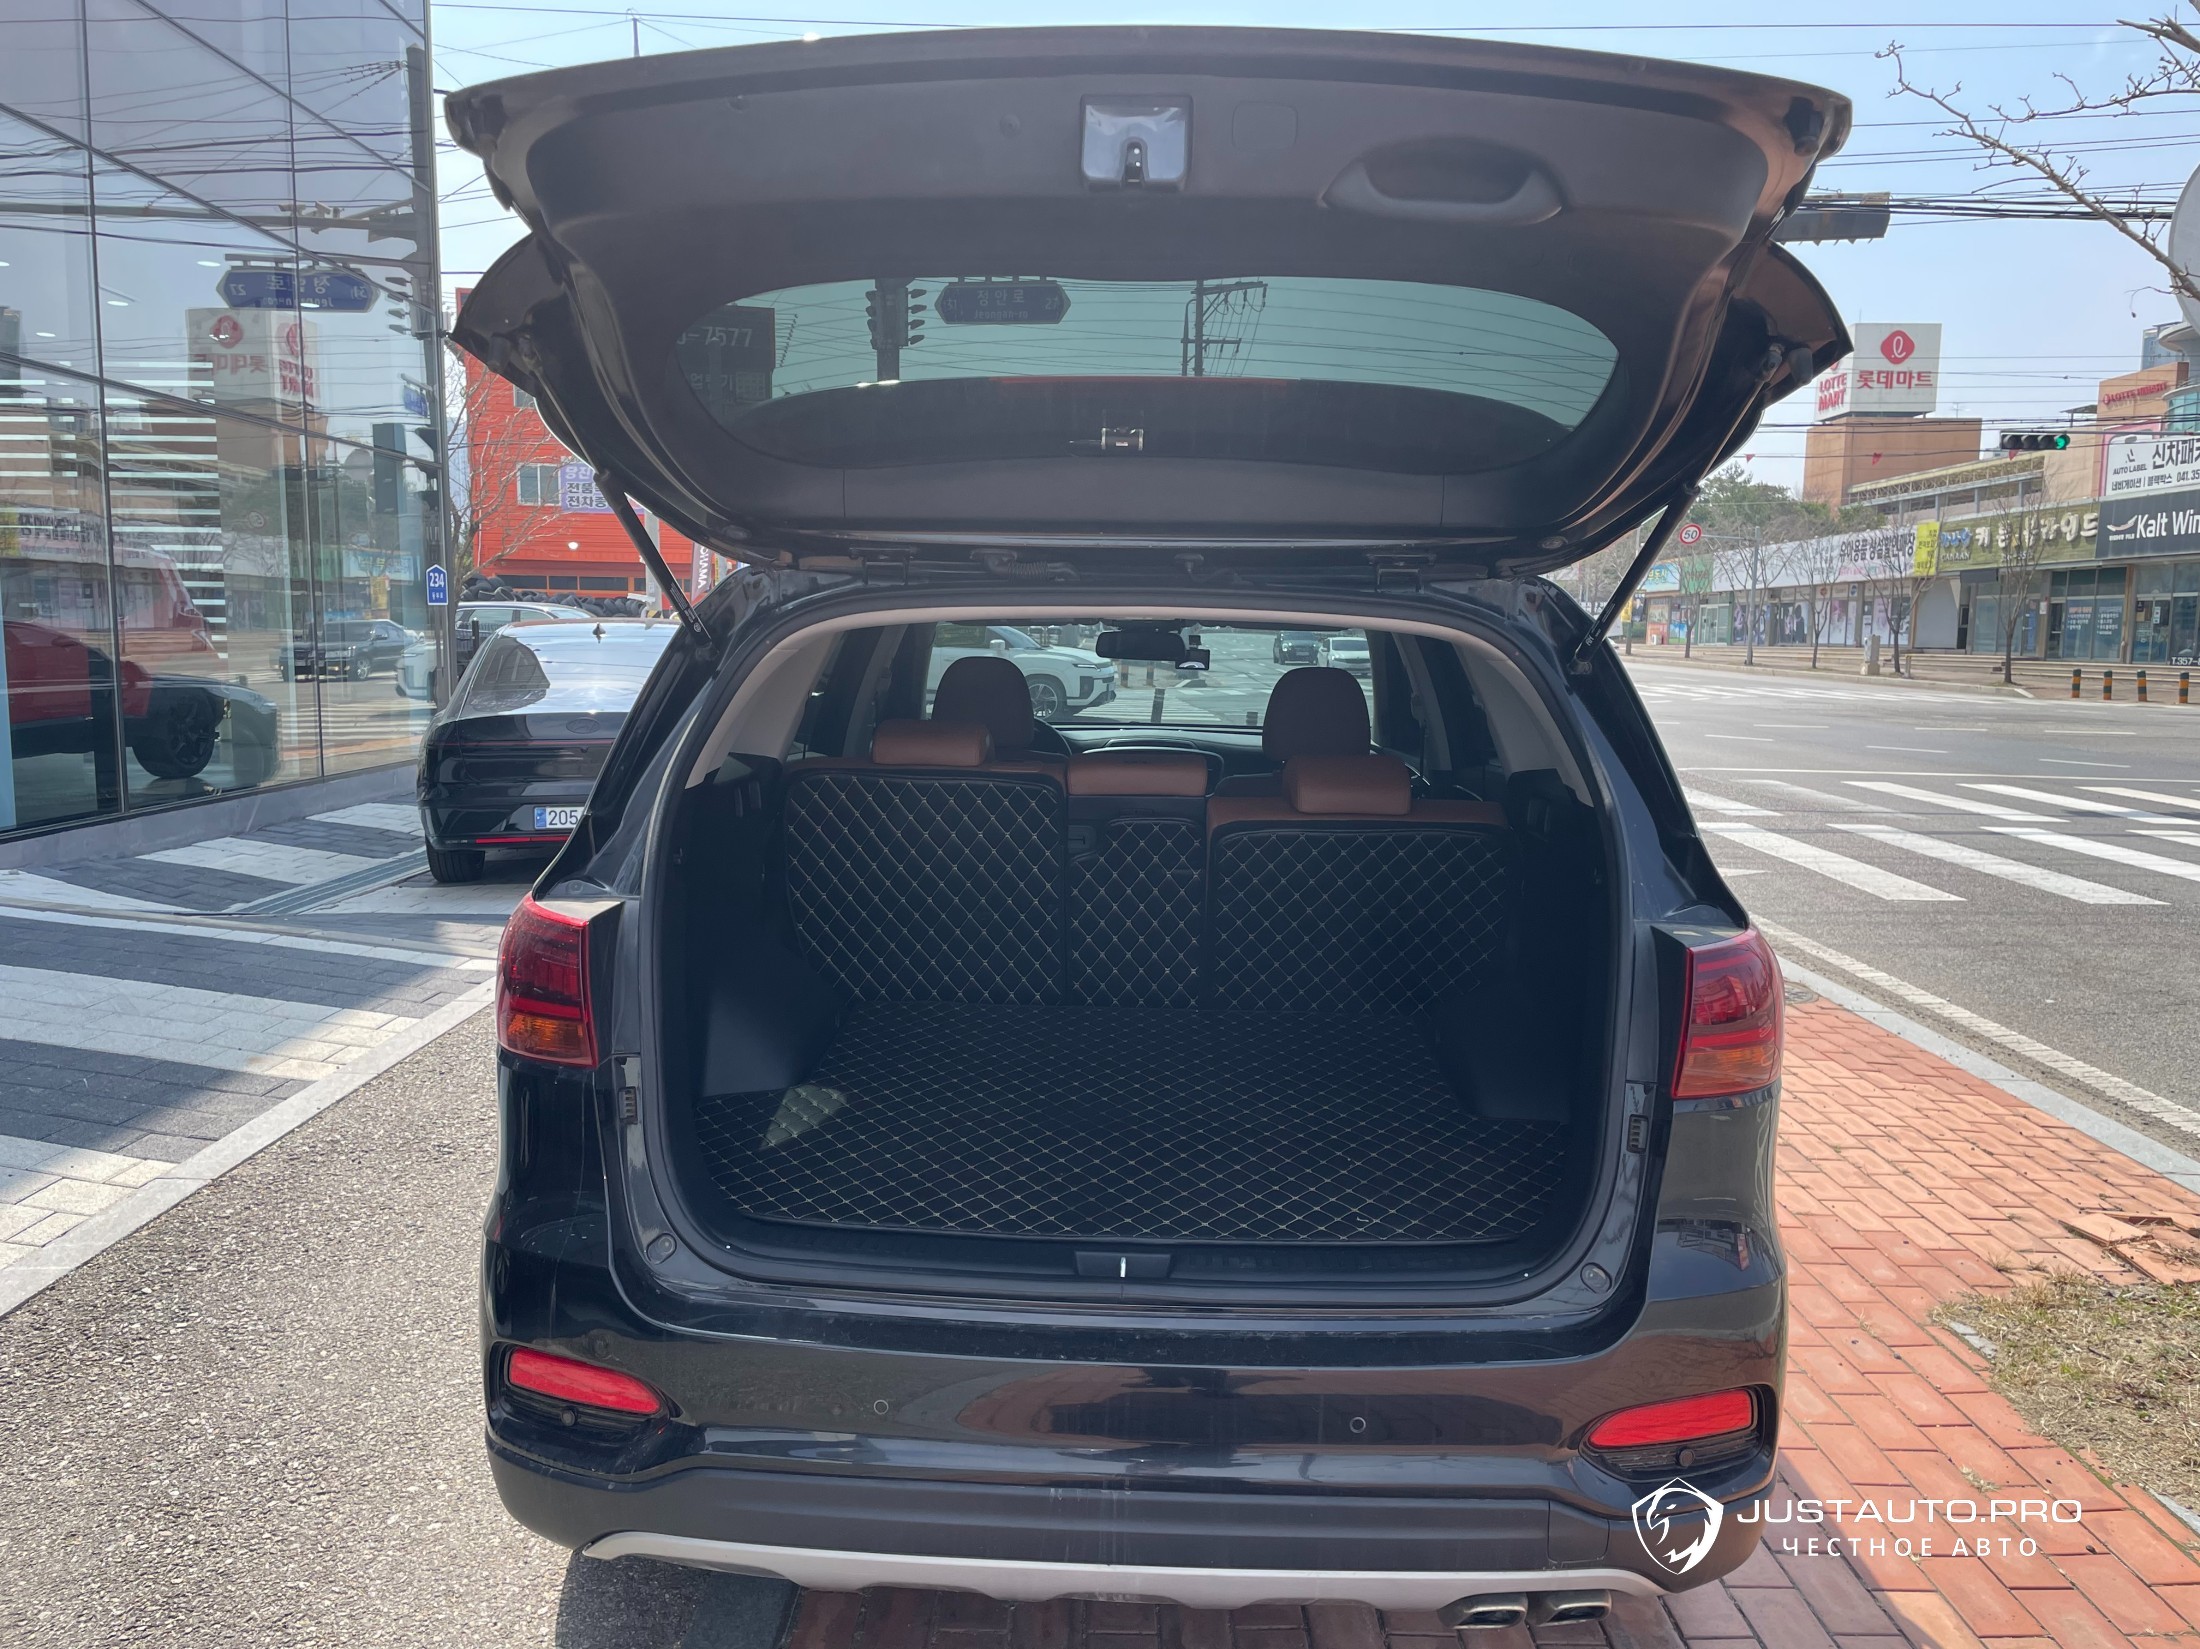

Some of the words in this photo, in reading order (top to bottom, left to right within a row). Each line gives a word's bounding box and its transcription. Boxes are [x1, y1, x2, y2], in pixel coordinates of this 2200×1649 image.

[977, 288, 1025, 306] 정안로
[1819, 372, 1847, 393] LOTTE
[1857, 370, 1933, 389] 롯데마트
[1818, 388, 1846, 411] MART
[2113, 465, 2128, 475] AUTO
[2129, 463, 2147, 473] LABEL
[567, 496, 607, 508] 전차종
[2136, 512, 2168, 539] Kalt
[1683, 530, 1698, 540] 50
[429, 572, 445, 588] 234
[548, 809, 579, 826] 205
